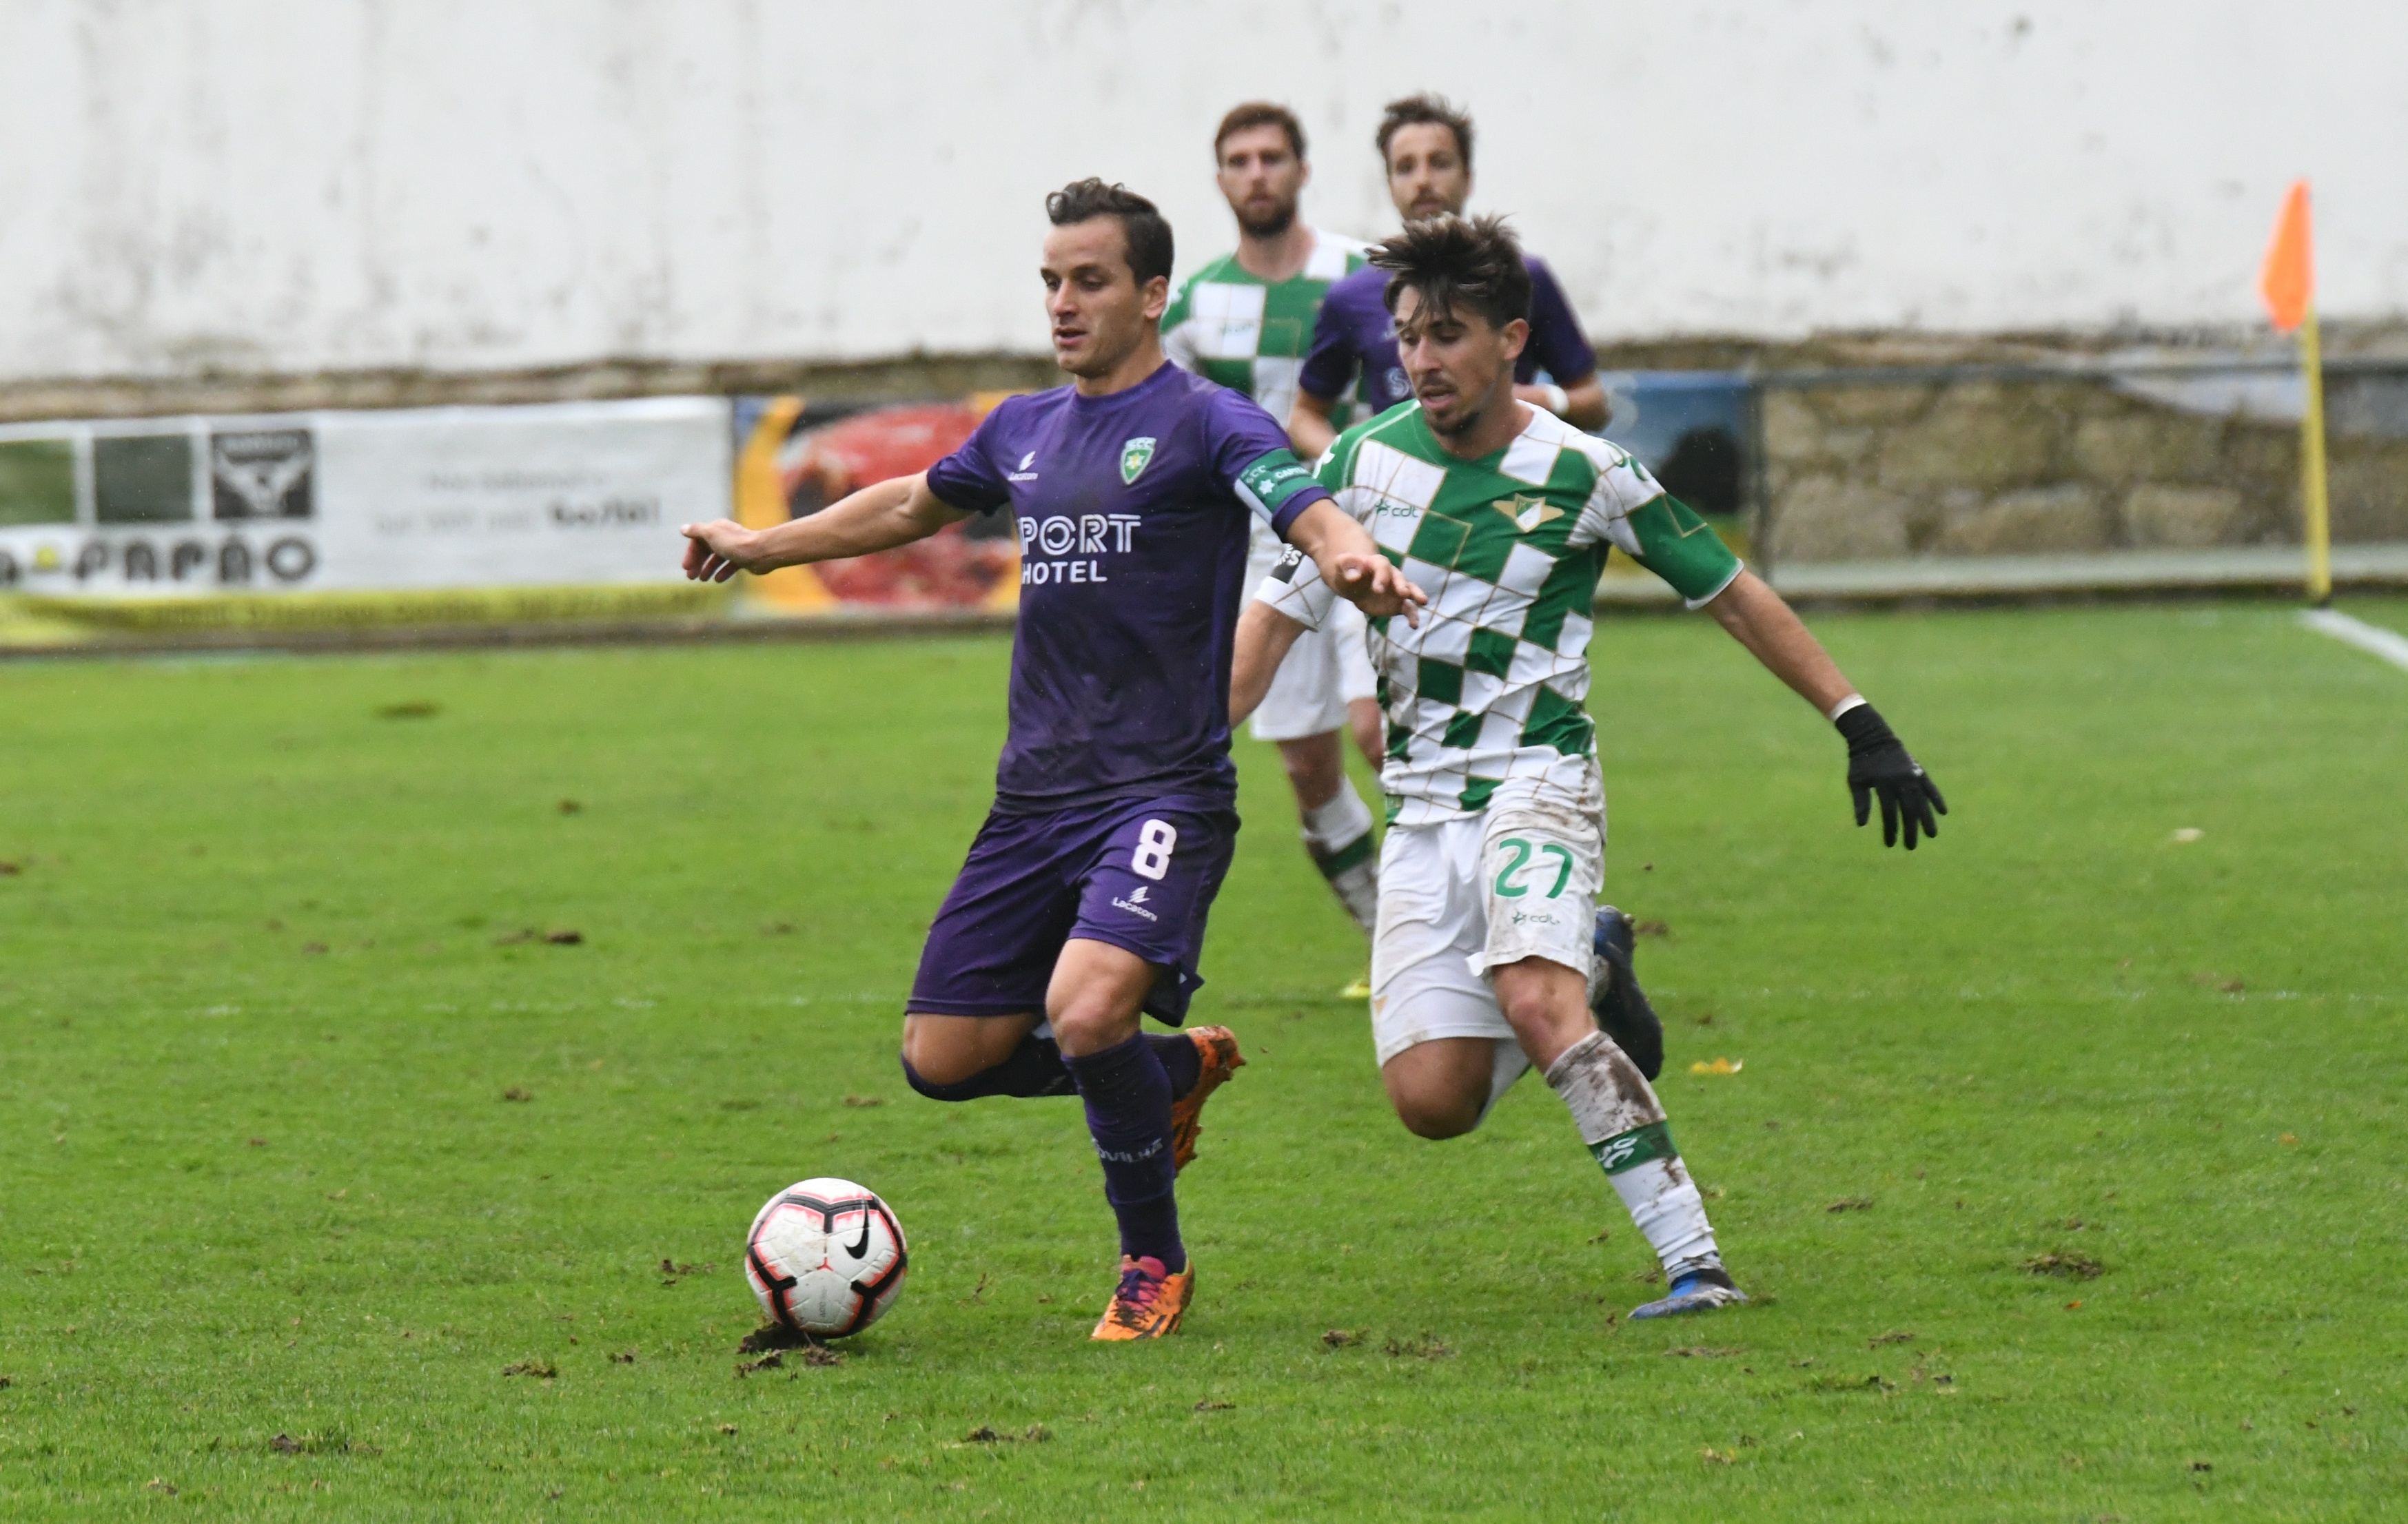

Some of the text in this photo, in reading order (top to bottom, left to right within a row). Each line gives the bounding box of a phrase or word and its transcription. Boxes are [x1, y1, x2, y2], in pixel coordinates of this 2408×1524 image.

[1022, 560, 1108, 584] HOTEL
[1132, 818, 1177, 881] 8
[1495, 837, 1573, 899] 27
